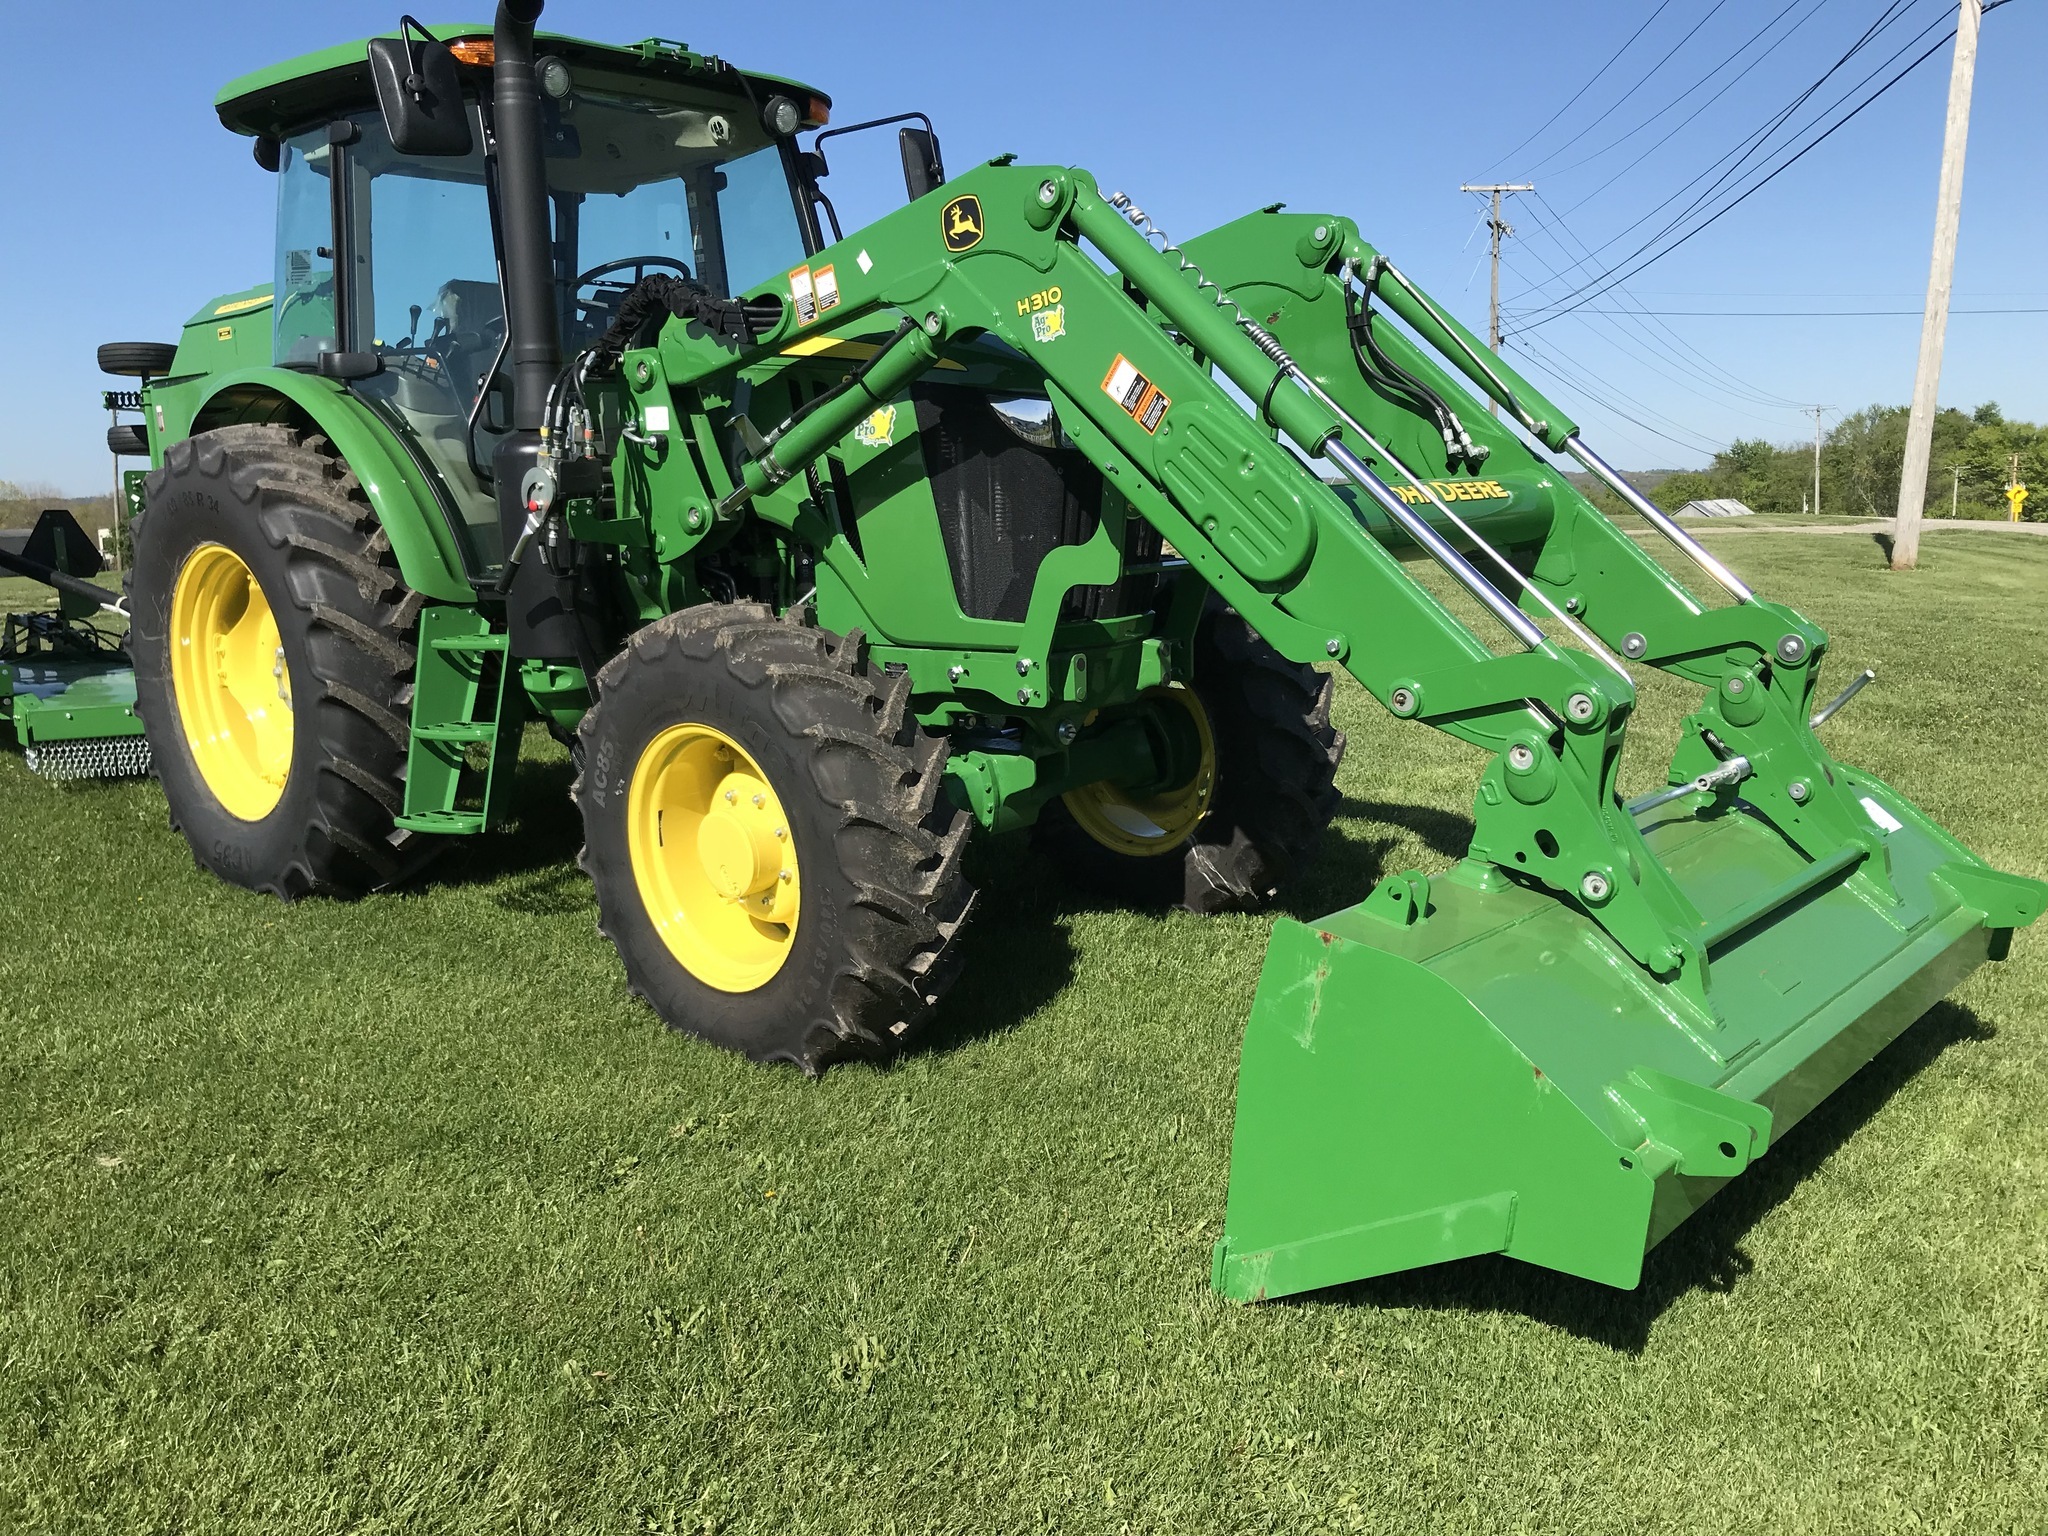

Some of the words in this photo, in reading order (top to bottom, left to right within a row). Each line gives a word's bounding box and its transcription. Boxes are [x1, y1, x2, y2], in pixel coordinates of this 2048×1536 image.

[1016, 285, 1063, 318] H310
[1036, 325, 1052, 338] Pro
[857, 423, 876, 437] Pro
[1429, 479, 1510, 503] DEERE
[592, 737, 615, 809] AC85
